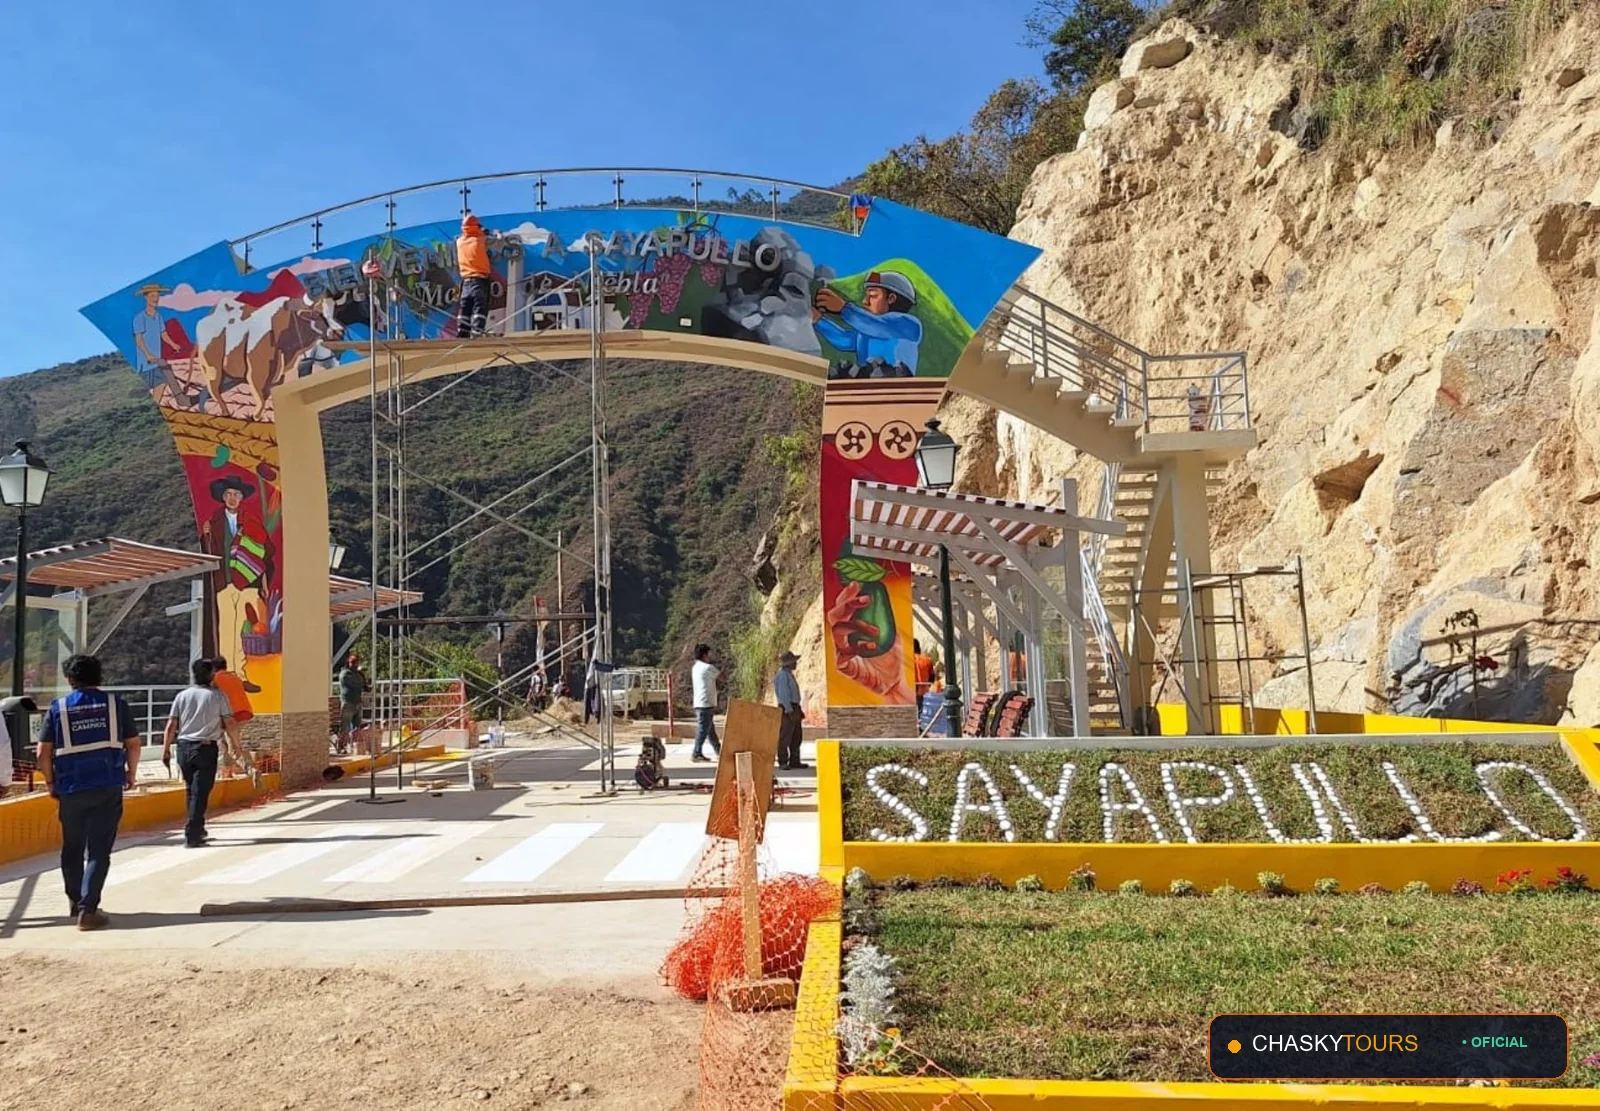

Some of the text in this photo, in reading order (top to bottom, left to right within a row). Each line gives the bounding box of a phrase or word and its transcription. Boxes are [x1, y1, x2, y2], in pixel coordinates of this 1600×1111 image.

[541, 230, 566, 260] A
[583, 227, 782, 272] SAYAPULLO
[865, 761, 1587, 844] SAYAPULLO
